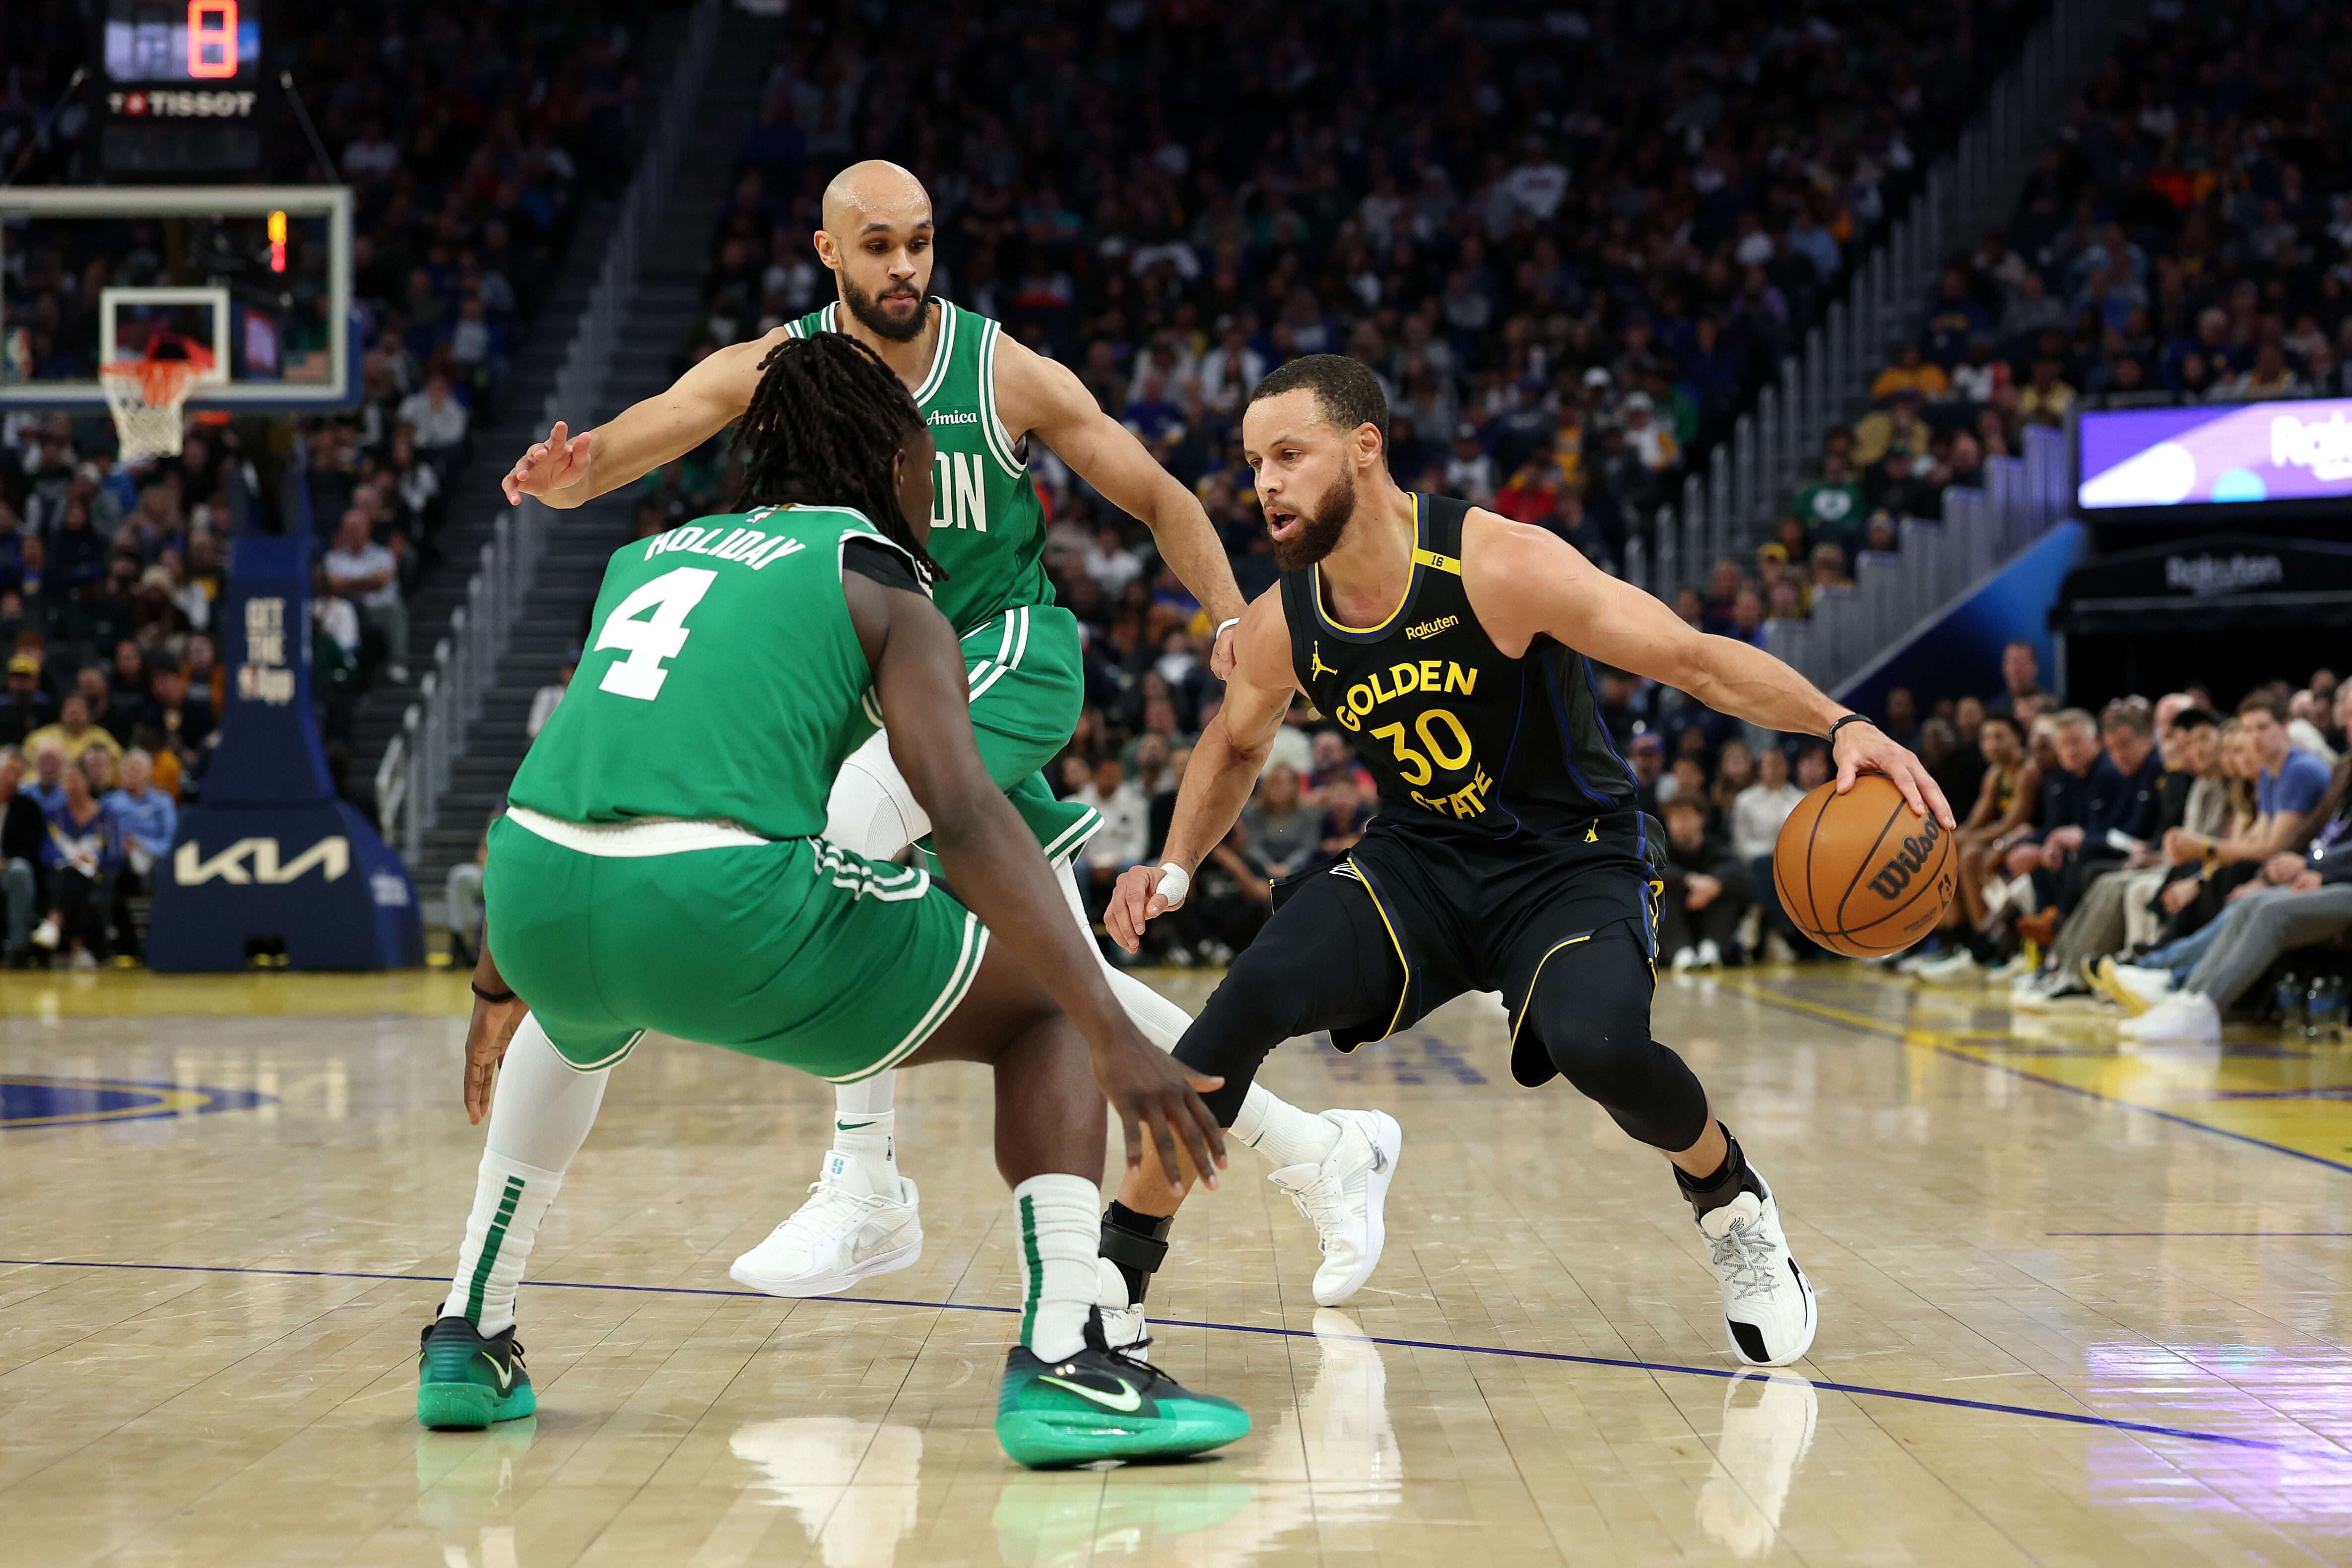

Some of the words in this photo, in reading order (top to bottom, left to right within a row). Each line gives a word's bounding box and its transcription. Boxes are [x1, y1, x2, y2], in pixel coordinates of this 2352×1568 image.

[187, 0, 239, 78] 8
[149, 91, 256, 118] TISSOT
[926, 410, 978, 425] Amica
[644, 526, 806, 571] HOLIDAY
[1431, 555, 1444, 567] 16
[593, 566, 719, 702] 4
[1405, 615, 1459, 640] Rakuten
[1336, 660, 1478, 732] GOLDEN
[1369, 709, 1472, 786] 30
[1411, 762, 1493, 819] STATE
[1867, 812, 1940, 901] Wilso
